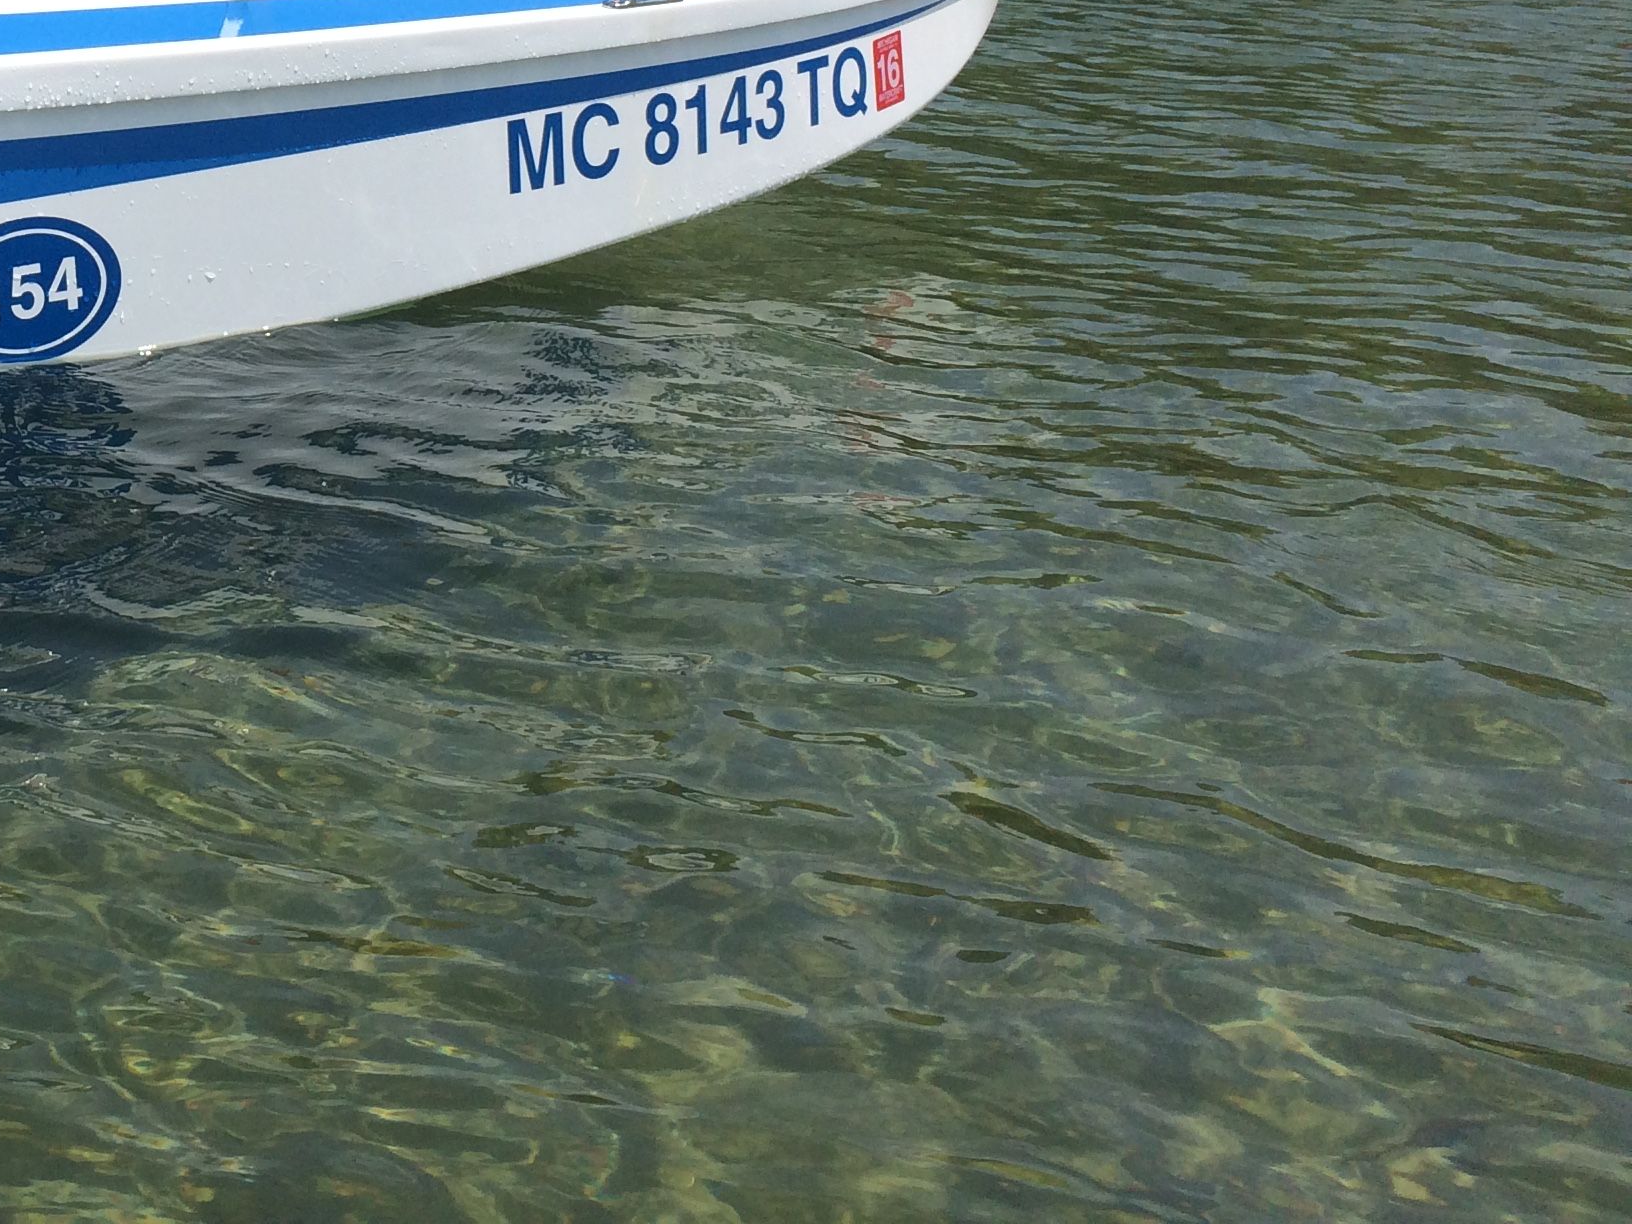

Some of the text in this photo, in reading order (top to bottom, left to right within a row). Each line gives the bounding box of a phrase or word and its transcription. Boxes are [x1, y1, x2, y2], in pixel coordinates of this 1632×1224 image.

[877, 49, 901, 91] 16
[506, 46, 868, 195] MC 8143 TQ
